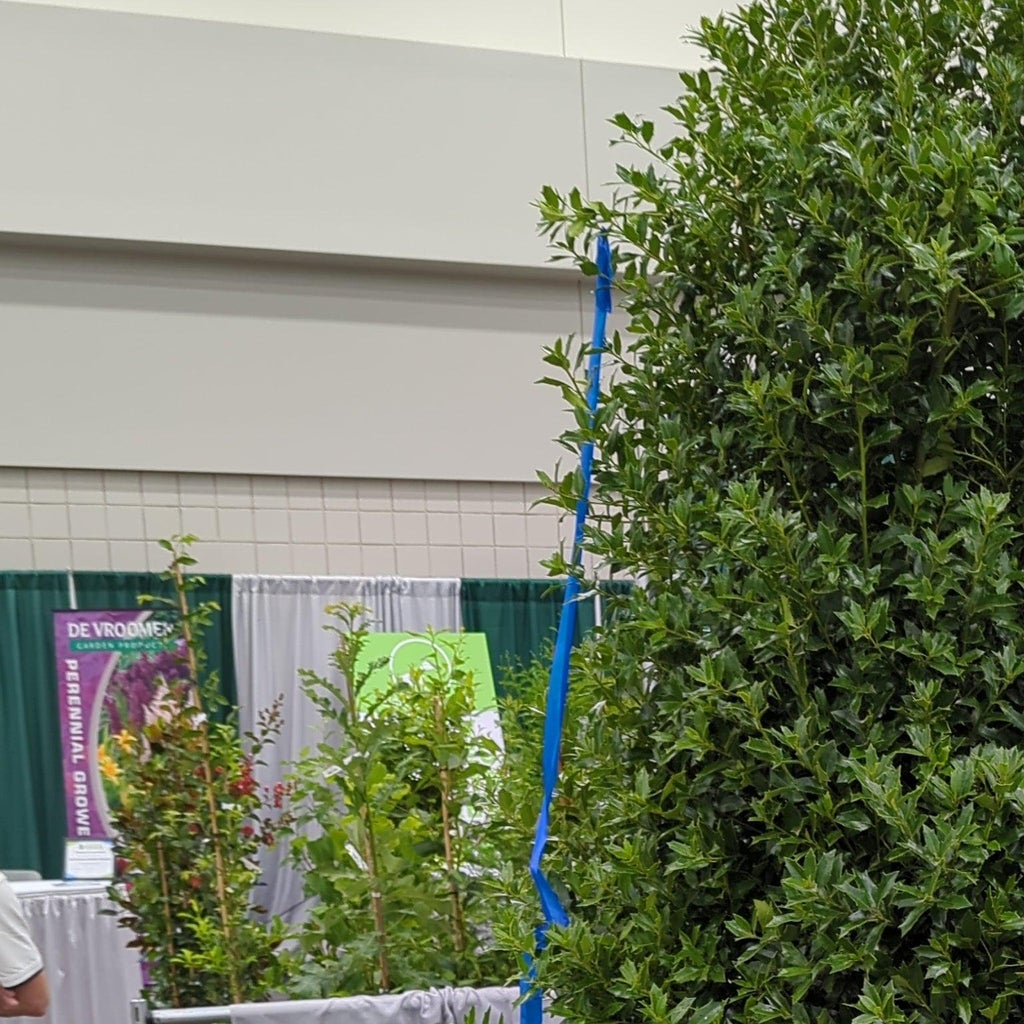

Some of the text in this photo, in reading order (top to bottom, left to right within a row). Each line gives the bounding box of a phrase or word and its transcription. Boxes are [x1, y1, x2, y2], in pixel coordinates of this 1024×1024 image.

[67, 622, 90, 638] DE
[64, 659, 84, 764] PERENNIAL
[72, 771, 91, 837] GROWE
